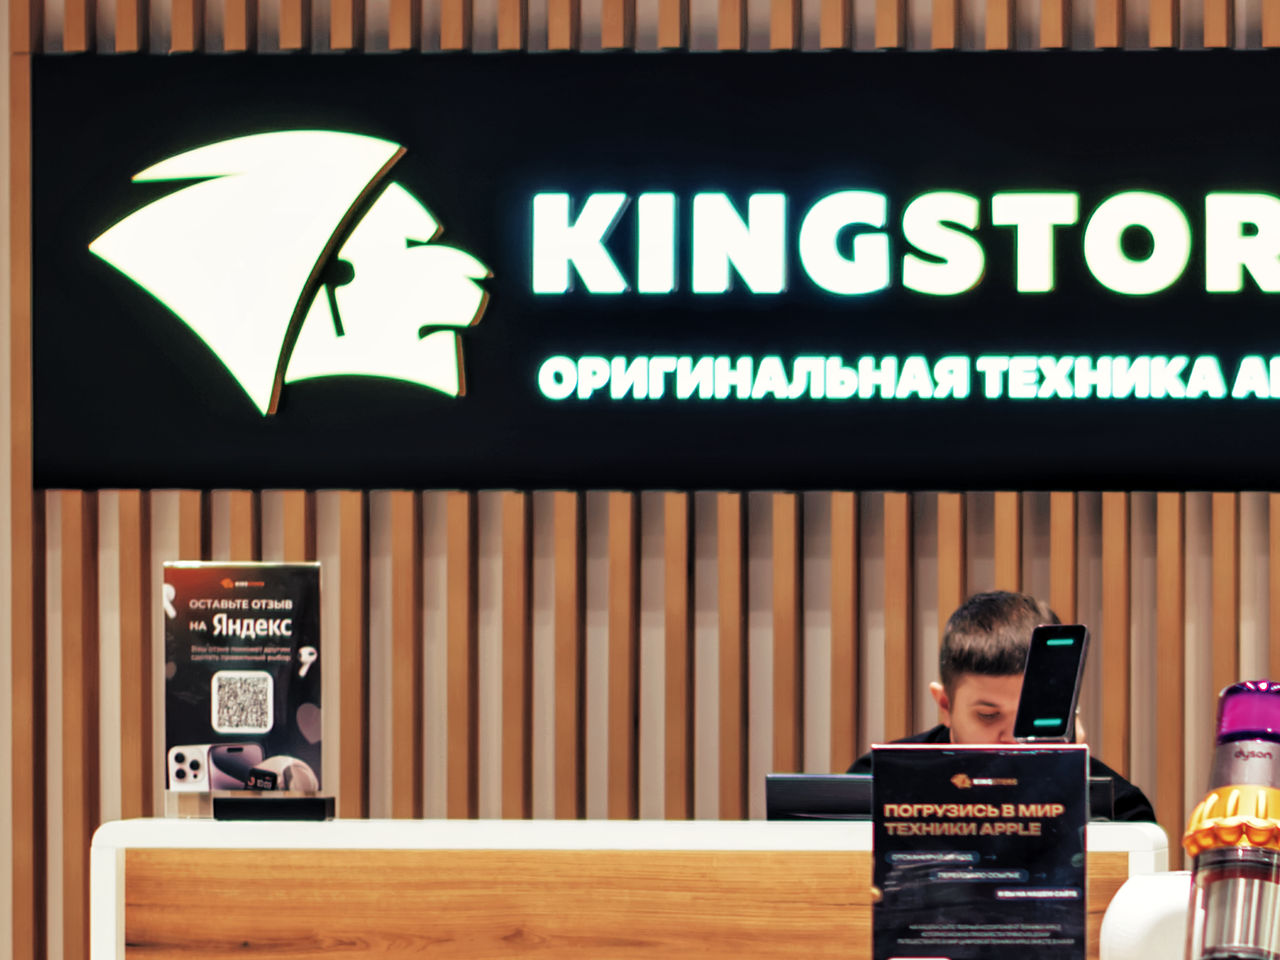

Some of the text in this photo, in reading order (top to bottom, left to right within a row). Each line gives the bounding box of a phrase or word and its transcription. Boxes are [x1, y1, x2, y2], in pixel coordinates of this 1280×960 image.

[537, 354, 973, 402] ОРИГИНАЛЬНАЯ
[975, 354, 1229, 402] ТЕХНИКА
[189, 599, 294, 610] ОСТАВЬТЕ ОТЗЫВ
[189, 613, 293, 640] НА Яндекс
[1234, 749, 1273, 761] dyson
[884, 803, 1065, 818] ПОГРУЗИСЬ В МИР
[883, 822, 1042, 836] ТЕХНИКИ APPLE
